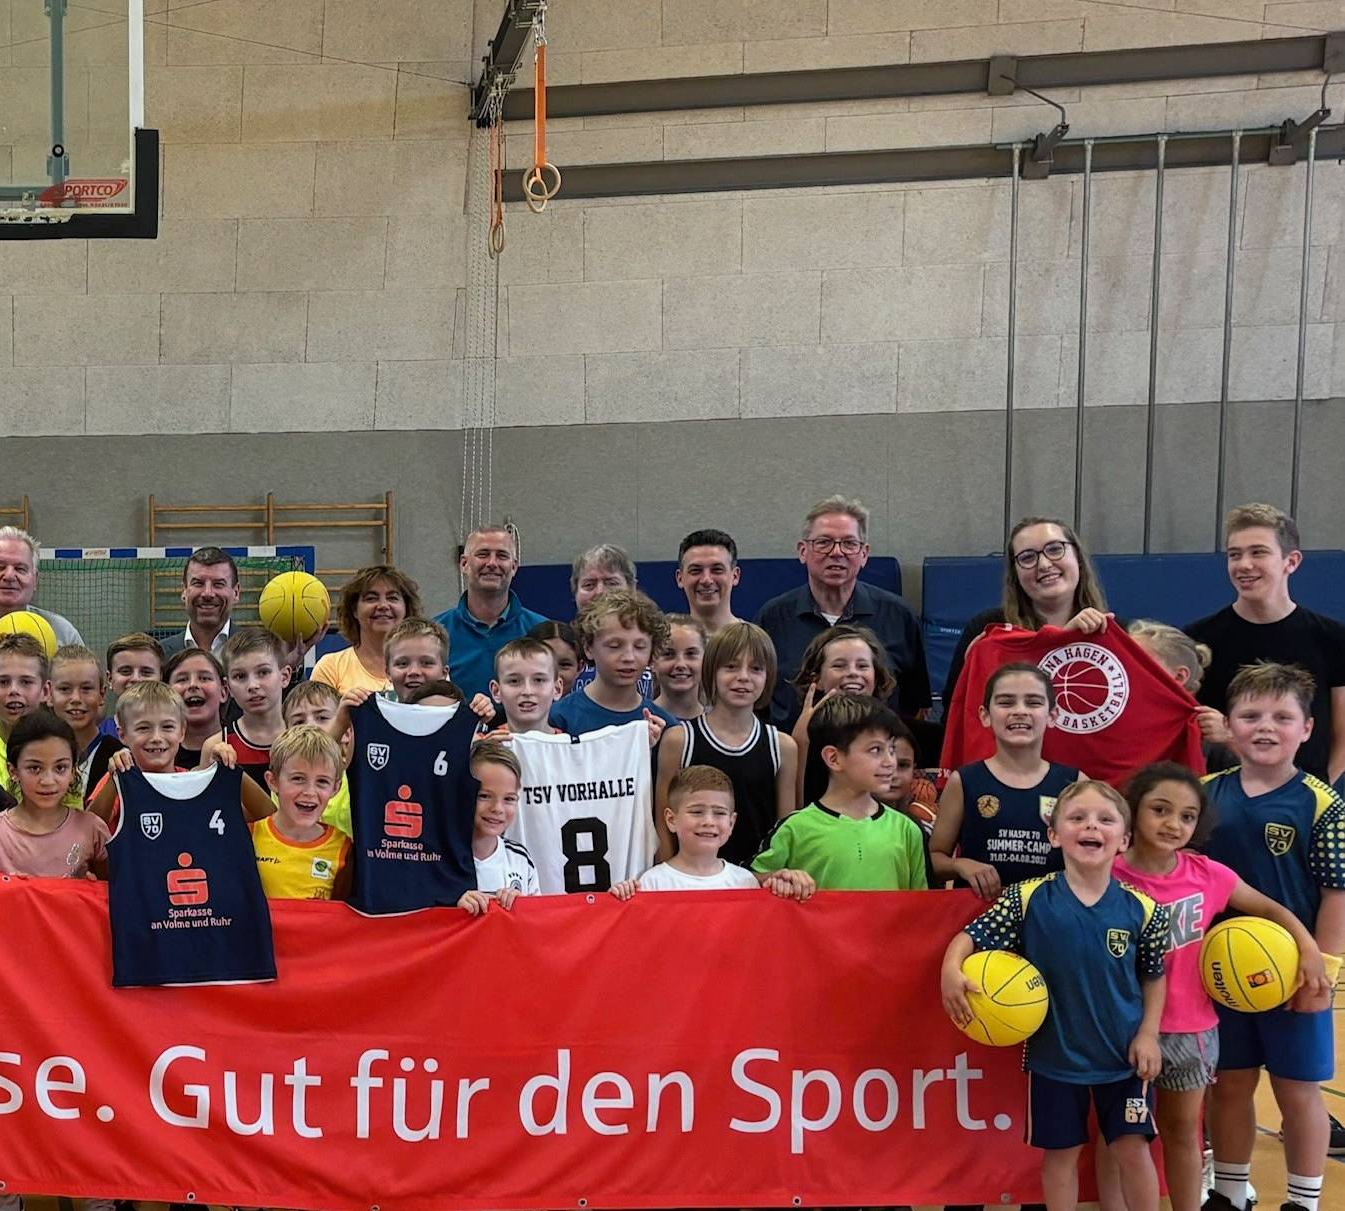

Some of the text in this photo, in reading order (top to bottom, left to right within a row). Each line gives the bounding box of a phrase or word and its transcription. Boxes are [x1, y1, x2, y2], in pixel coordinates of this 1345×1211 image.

[56, 184, 114, 197] PORTCO
[1064, 647, 1109, 666] HAGEN
[1062, 673, 1124, 729] BASKETBALL
[369, 746, 386, 756] SV
[371, 756, 385, 765] 70
[433, 750, 448, 776] 6
[523, 777, 634, 804] TSV VORHALLE
[143, 816, 160, 825] SV
[209, 809, 225, 835] 4
[145, 825, 159, 834] 70
[998, 828, 1041, 840] SV HASPE 70
[1268, 826, 1291, 837] SV
[380, 838, 424, 851] Sparkasse
[1269, 838, 1287, 850] 70
[374, 849, 402, 860] Volme
[403, 850, 419, 861] und
[420, 852, 442, 862] Ruhr
[561, 816, 611, 894] 8
[168, 907, 213, 919] Sparkasse
[151, 916, 233, 930] an Volme und Ruhr
[1110, 931, 1127, 941] SV
[1110, 942, 1125, 953] 70
[148, 1043, 324, 1140] Gut
[349, 1047, 490, 1142] für
[519, 1048, 695, 1137] den
[728, 1047, 1013, 1155] Sport.
